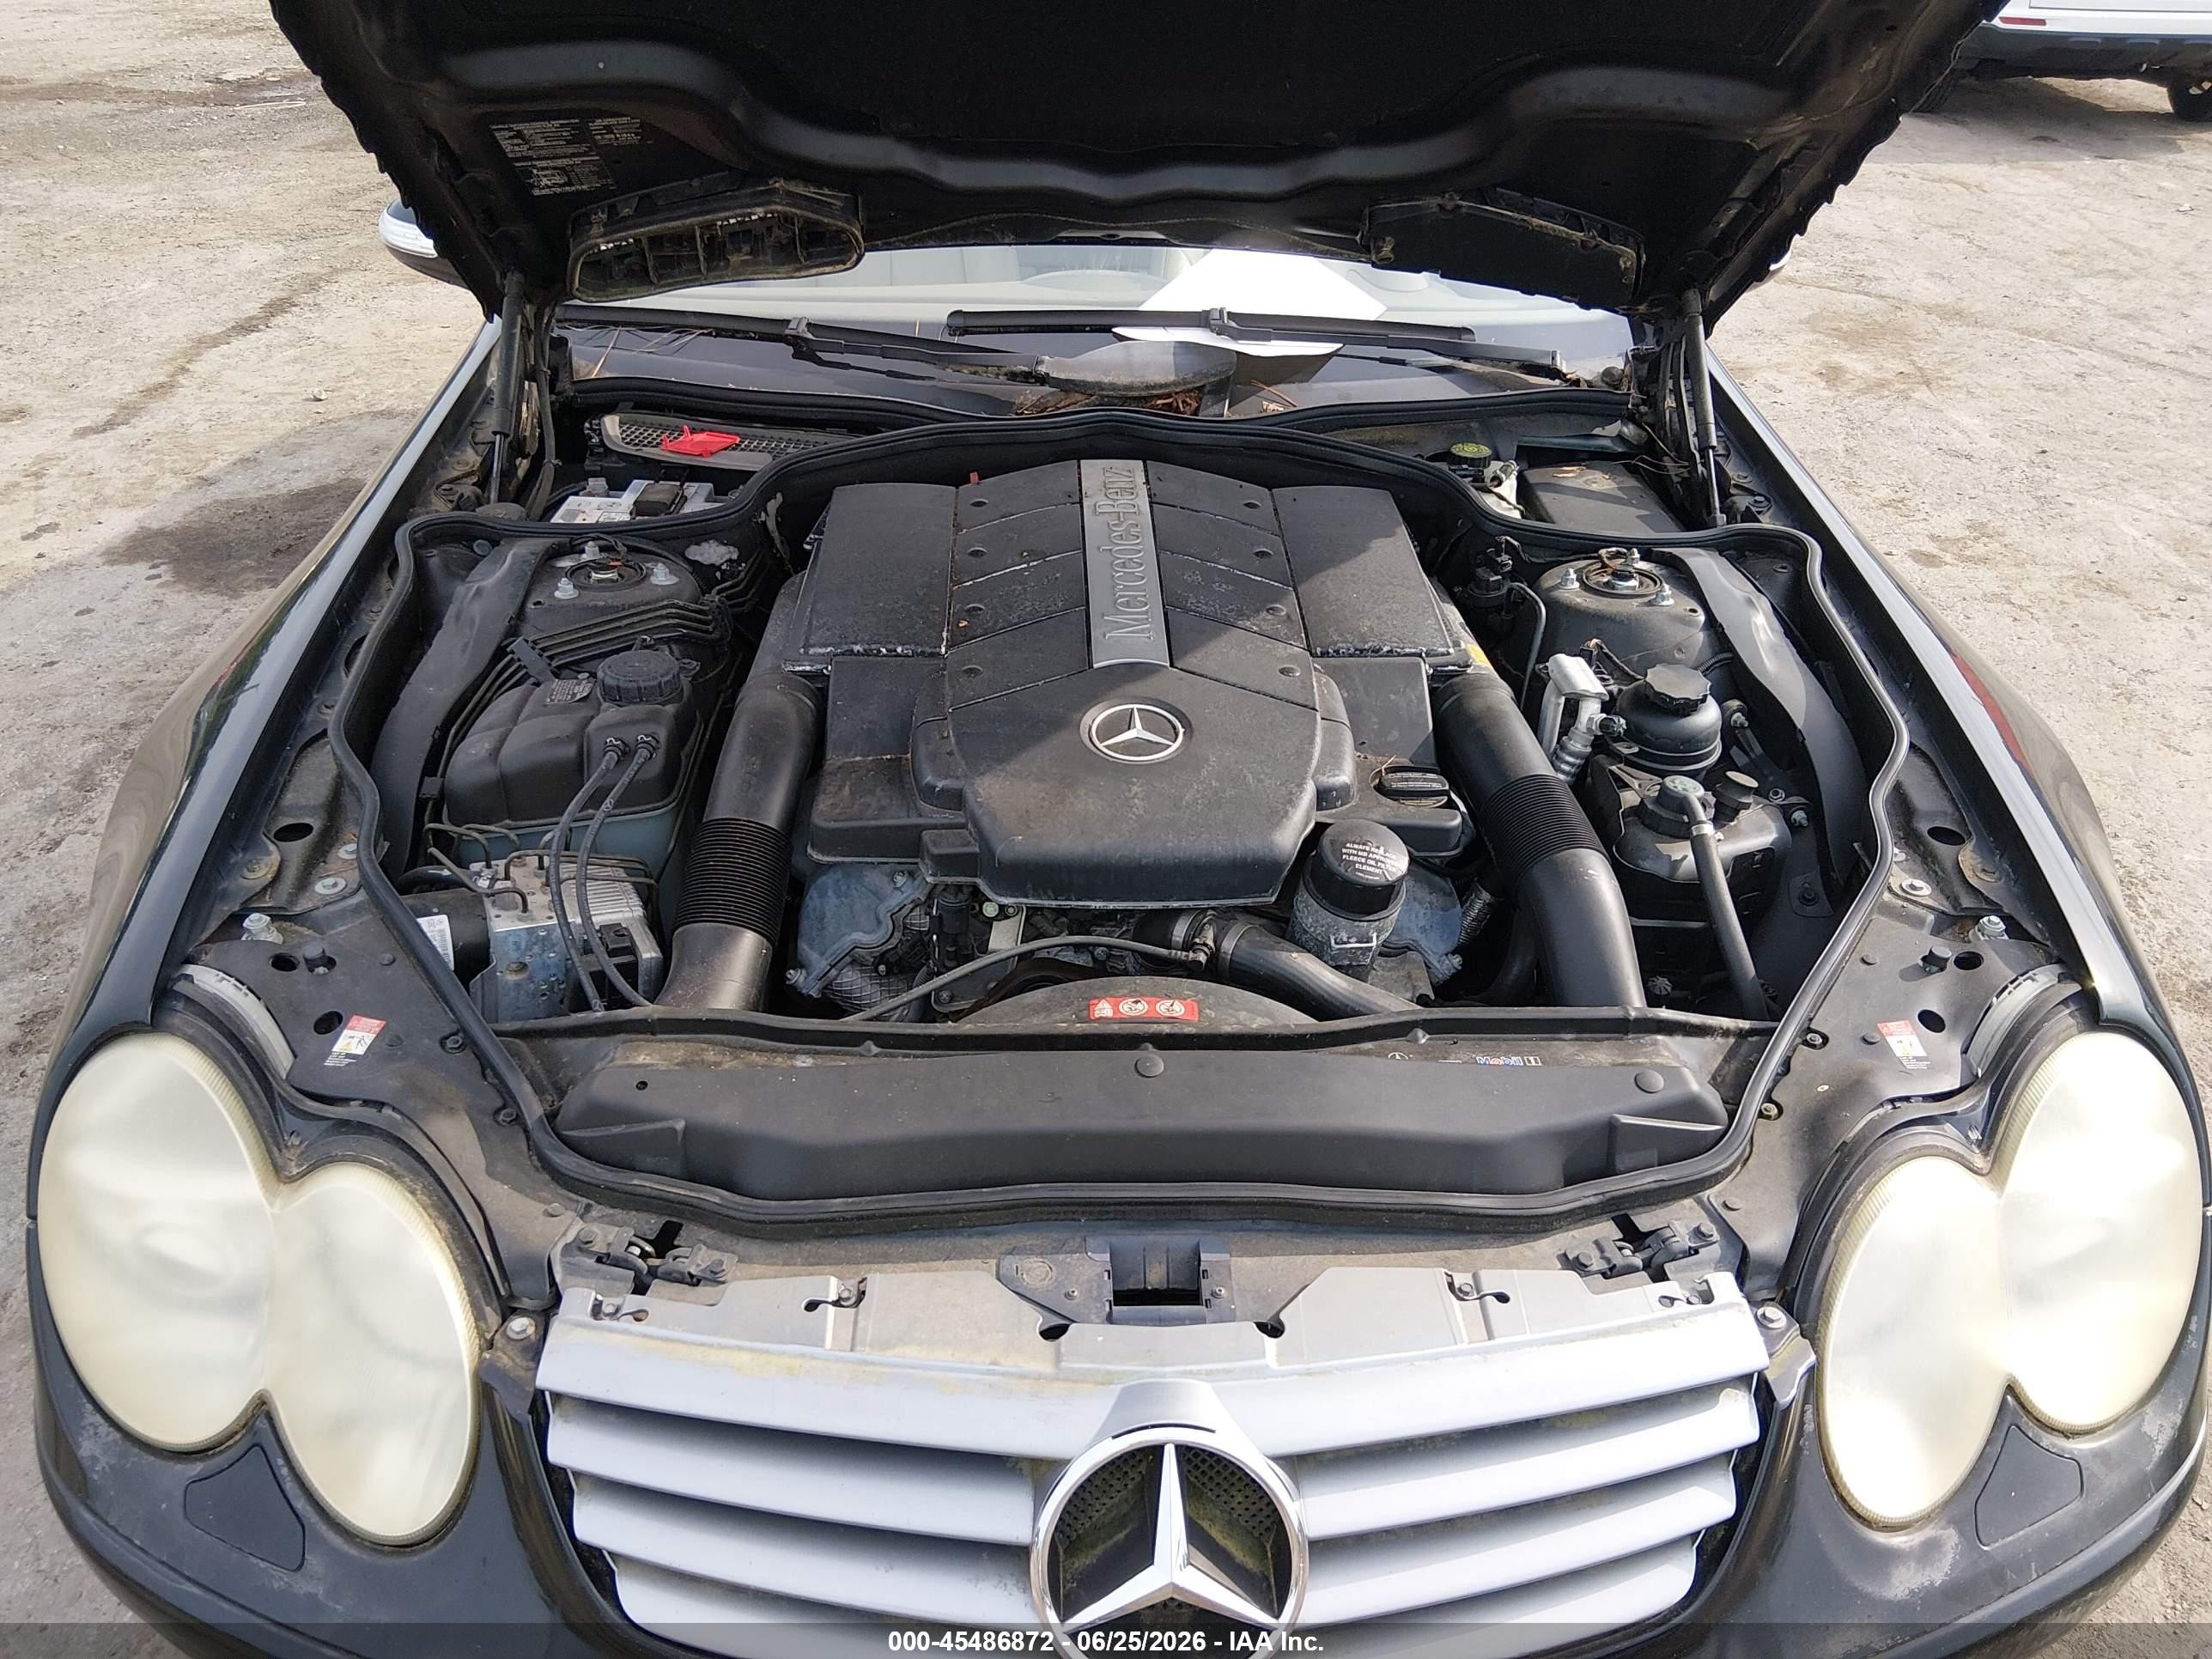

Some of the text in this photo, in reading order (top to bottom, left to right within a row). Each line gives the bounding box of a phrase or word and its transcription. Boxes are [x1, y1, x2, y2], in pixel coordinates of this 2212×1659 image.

[1096, 467, 1154, 641] Mercedes-Benz
[1346, 842, 1370, 851] ALWAYS
[1342, 854, 1366, 863] FLEECE
[1355, 863, 1382, 874] ELEMENT
[1476, 1056, 1523, 1066] Mobil
